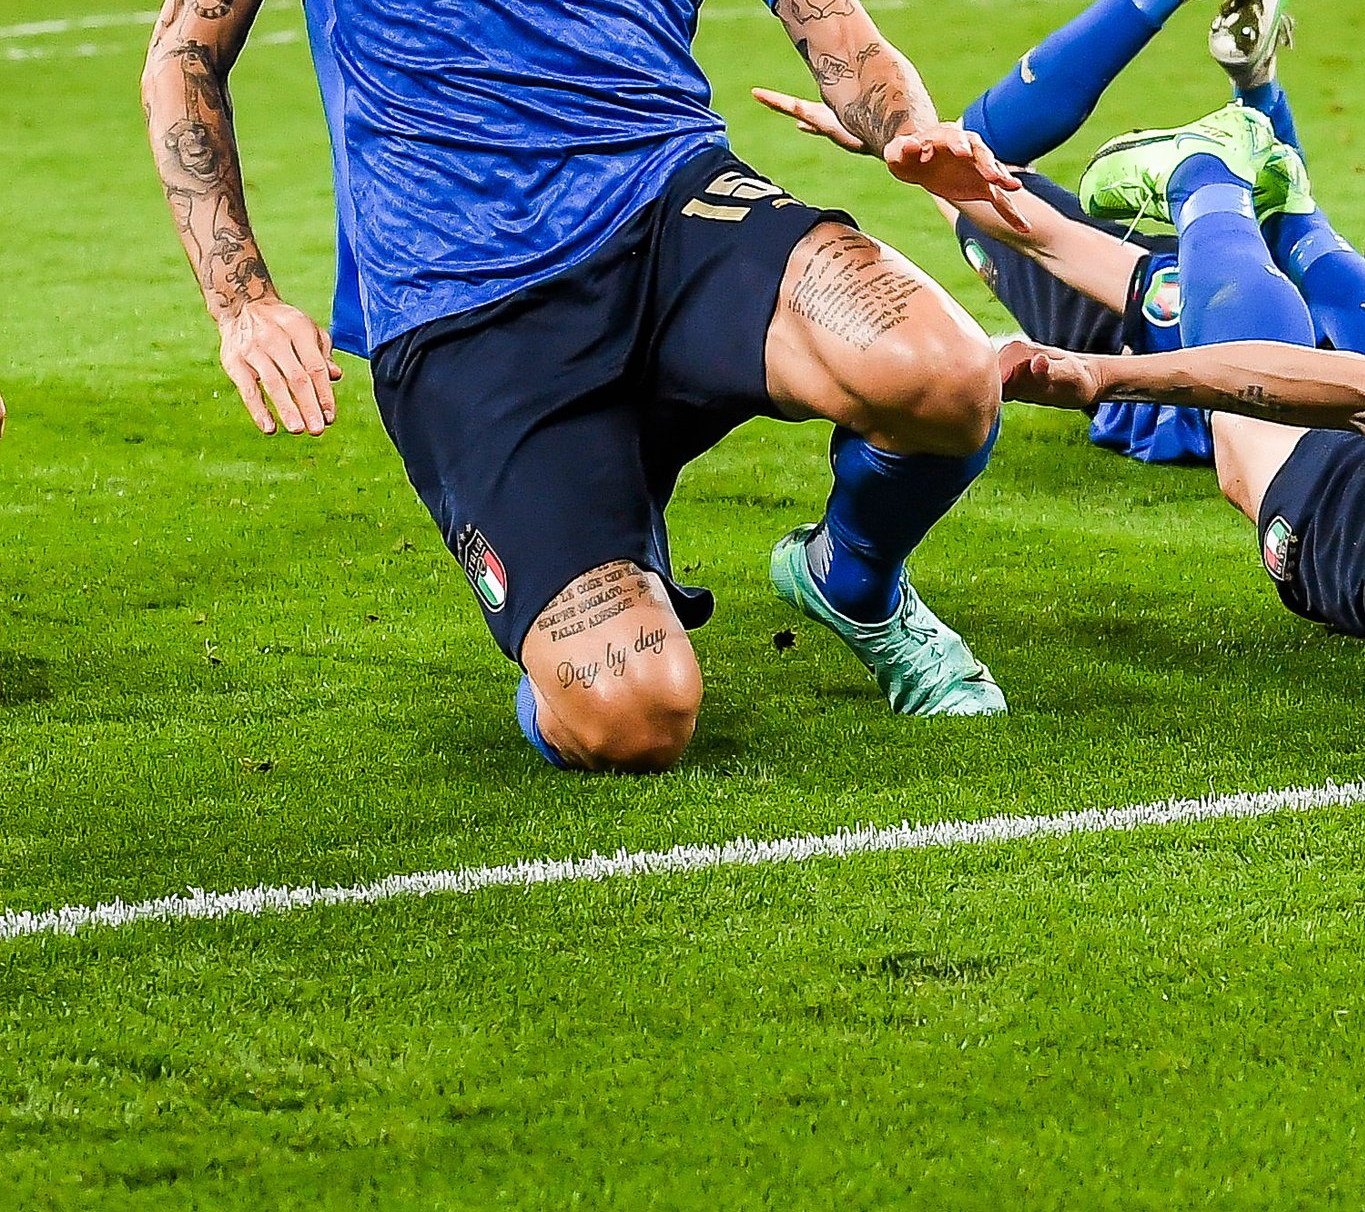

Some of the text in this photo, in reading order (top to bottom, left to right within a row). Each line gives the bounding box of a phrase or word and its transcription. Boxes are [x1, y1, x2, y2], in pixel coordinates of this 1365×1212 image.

[680, 170, 785, 222] 15
[468, 537, 485, 577] ITALIA
[537, 606, 579, 632] SEMPRE
[550, 620, 586, 642] FALLE
[556, 625, 667, 689] Day by day
